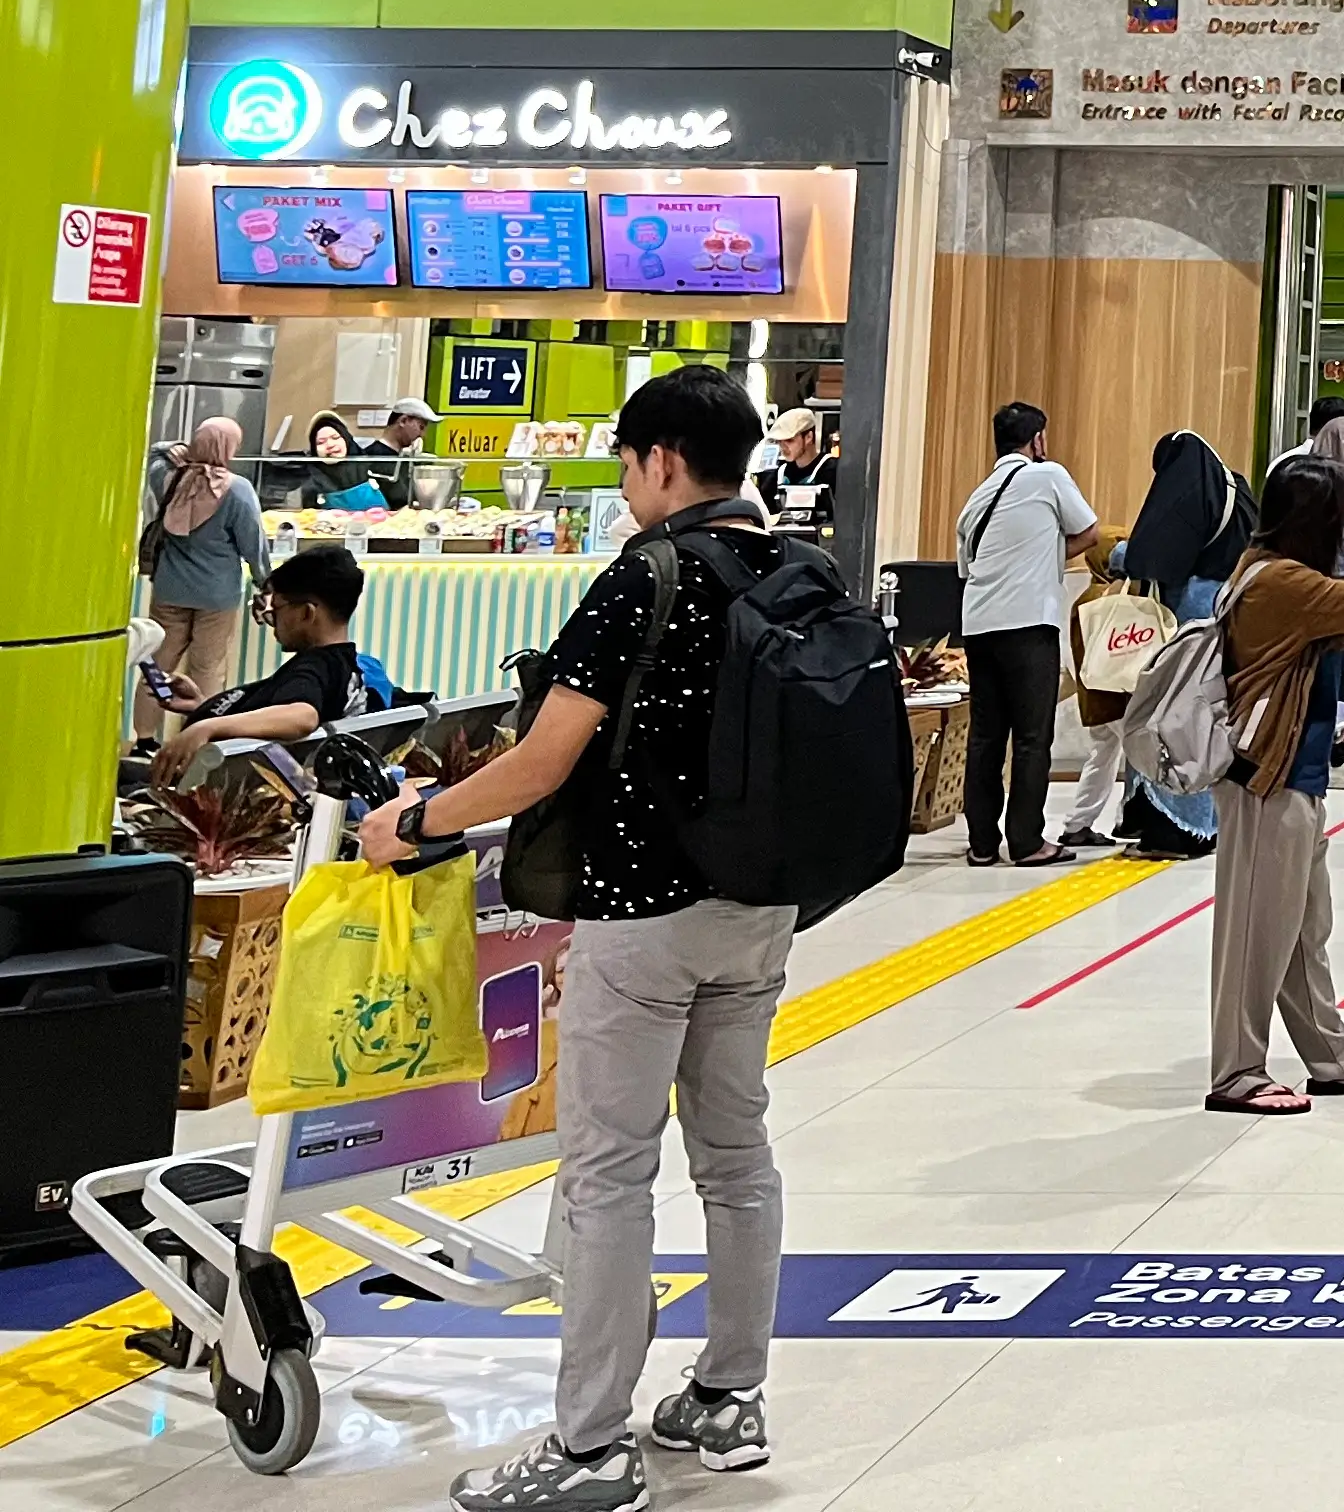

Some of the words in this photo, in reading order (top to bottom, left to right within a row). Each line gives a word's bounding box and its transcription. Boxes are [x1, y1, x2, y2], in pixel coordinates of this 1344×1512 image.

[1207, 17, 1321, 37] Departures
[1081, 68, 1170, 93] Masuk
[1181, 70, 1281, 100] dengan
[338, 79, 508, 148] Chez
[518, 79, 732, 150] Choux
[1081, 103, 1168, 121] Entrance
[1178, 102, 1222, 121] with
[1234, 102, 1290, 121] Facial
[263, 196, 309, 207] PAKET
[314, 196, 342, 207] MIX
[657, 203, 693, 212] PAKET
[460, 356, 496, 380] LIFT
[448, 429, 499, 453] Keluar
[414, 1164, 435, 1177] KAI
[446, 1155, 471, 1180] 31
[1120, 1261, 1326, 1282] Batas
[1094, 1283, 1293, 1304] Zona
